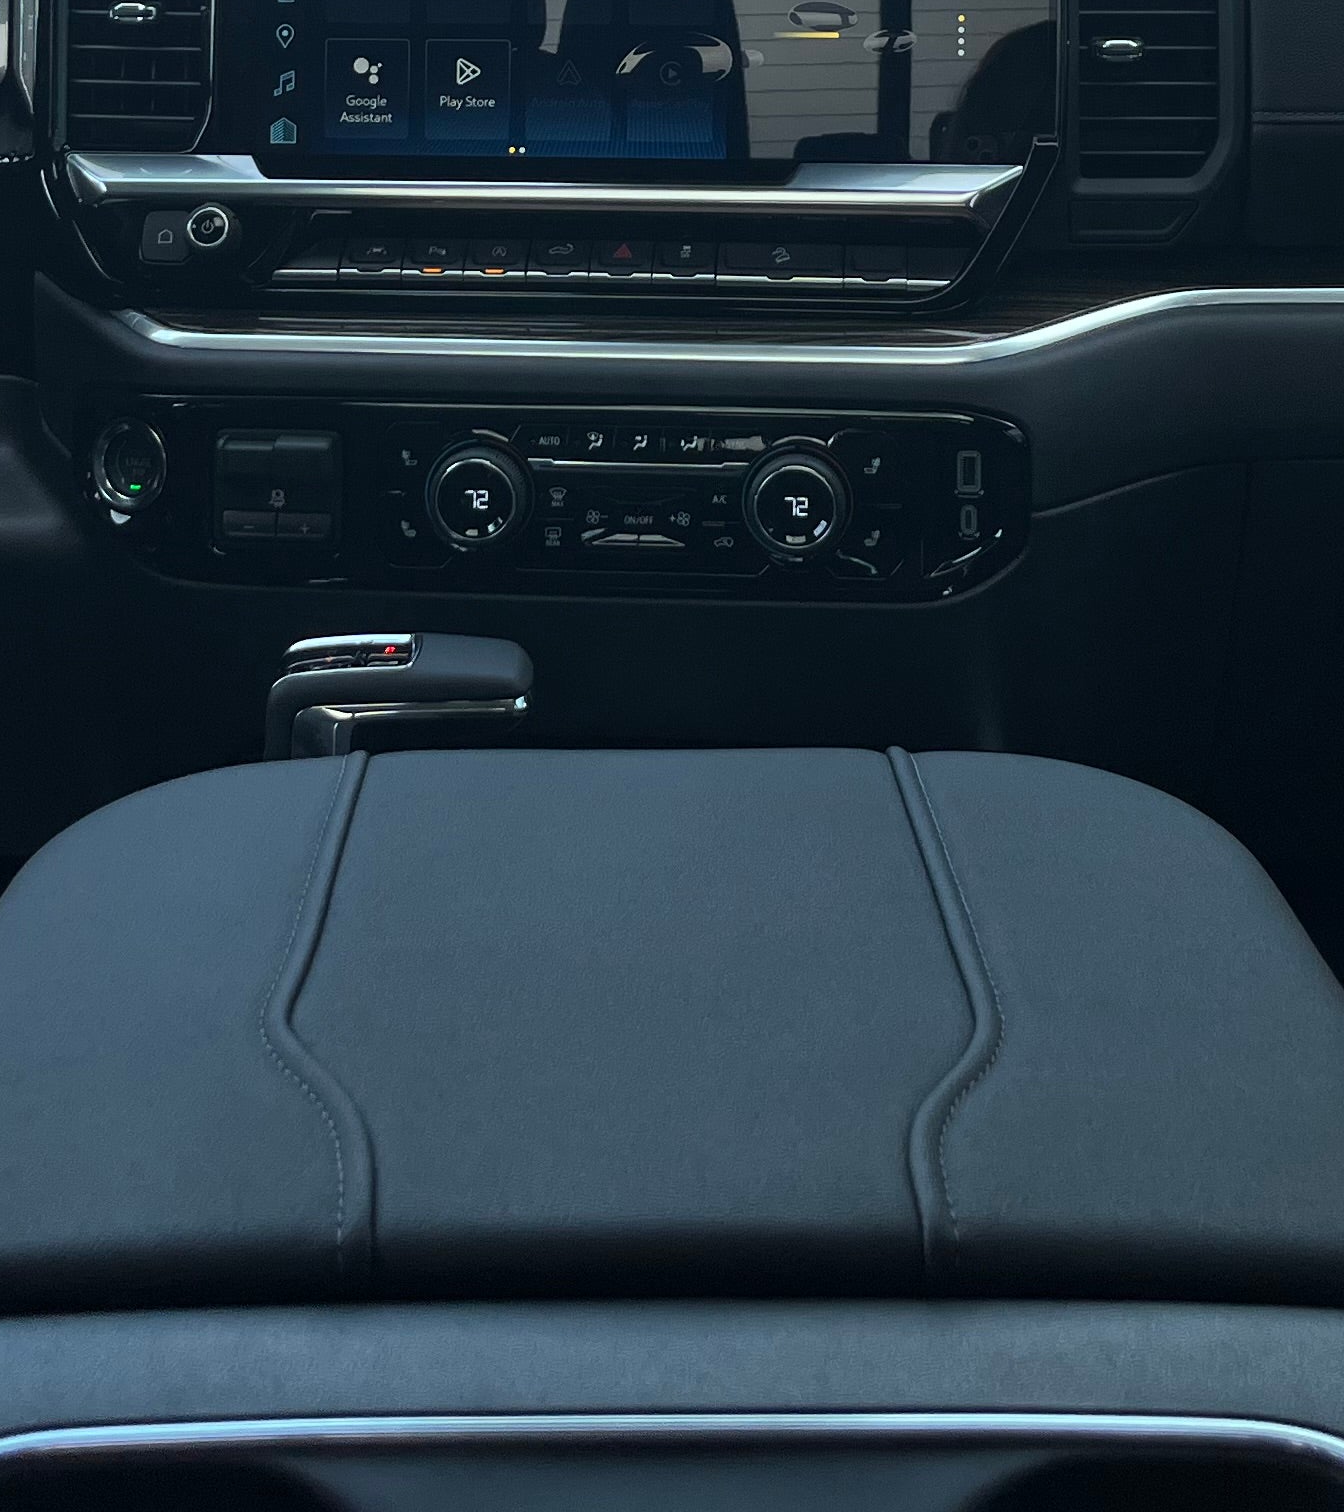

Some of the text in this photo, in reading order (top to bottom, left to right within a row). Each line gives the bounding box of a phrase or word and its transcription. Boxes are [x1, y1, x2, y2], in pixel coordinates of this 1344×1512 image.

[345, 94, 388, 109] Google
[439, 95, 496, 110] Play Store
[339, 111, 393, 123] Assistant
[538, 436, 560, 446] AUTO
[464, 489, 489, 510] 72
[712, 494, 727, 505] A/C
[784, 496, 809, 517] 72
[623, 515, 654, 526] ON/OFF
